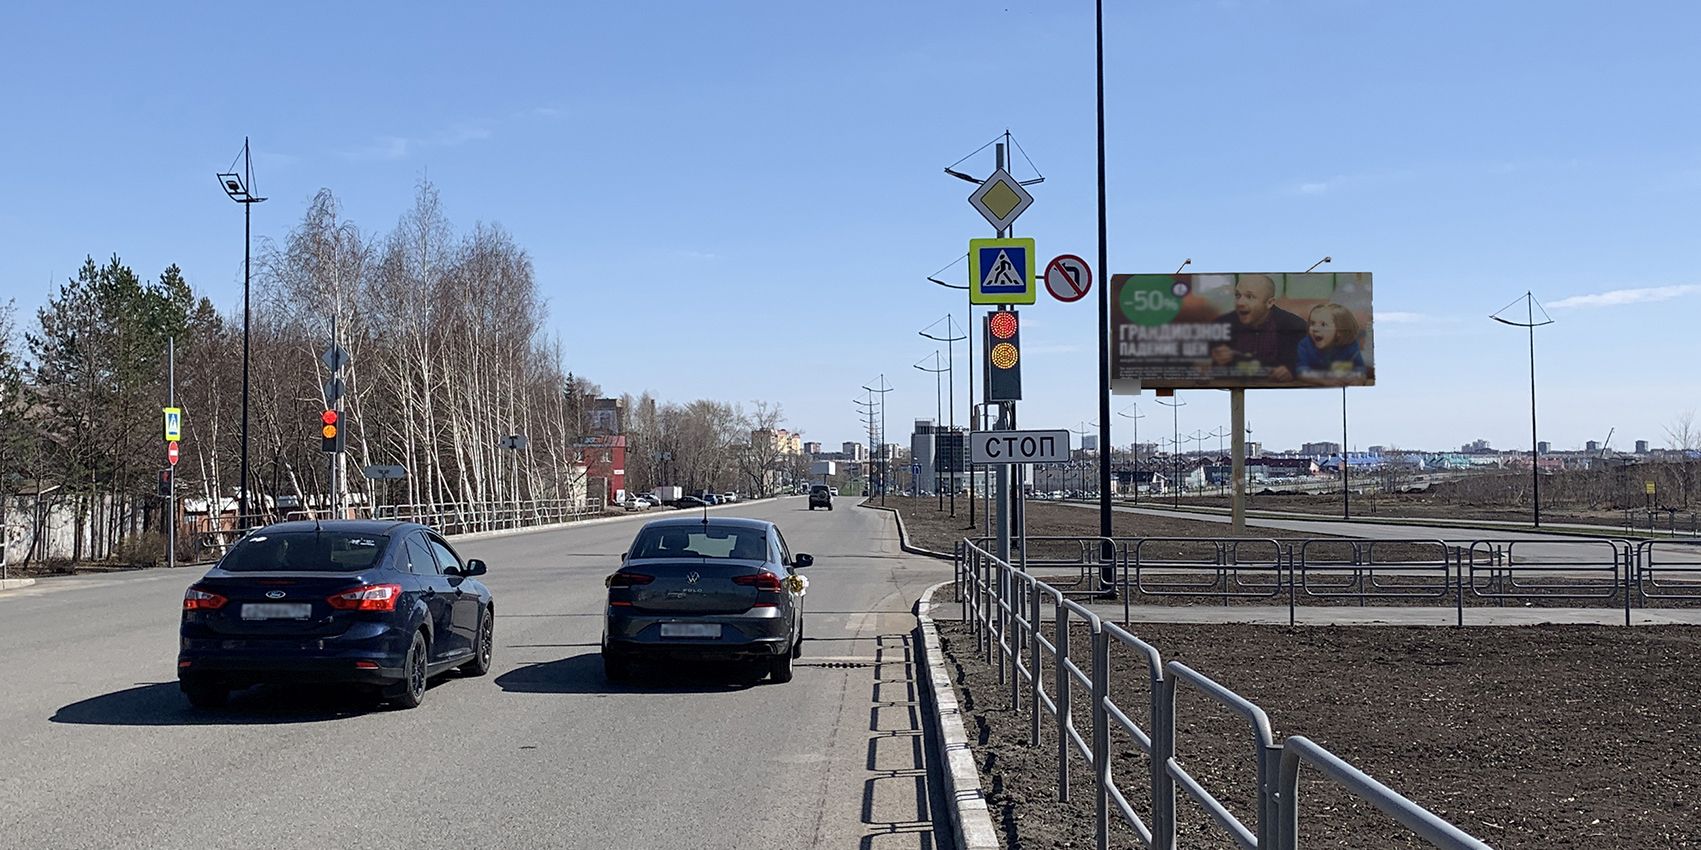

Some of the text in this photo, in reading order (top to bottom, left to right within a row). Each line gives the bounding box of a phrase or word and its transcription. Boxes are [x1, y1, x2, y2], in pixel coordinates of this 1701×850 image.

[1124, 290, 1179, 311] -50%
[1120, 323, 1231, 341] ГРАНДИОЗНОЕ
[1120, 342, 1208, 357] ПАДЕНИЕ ЦЕН
[985, 436, 1054, 458] СТОП
